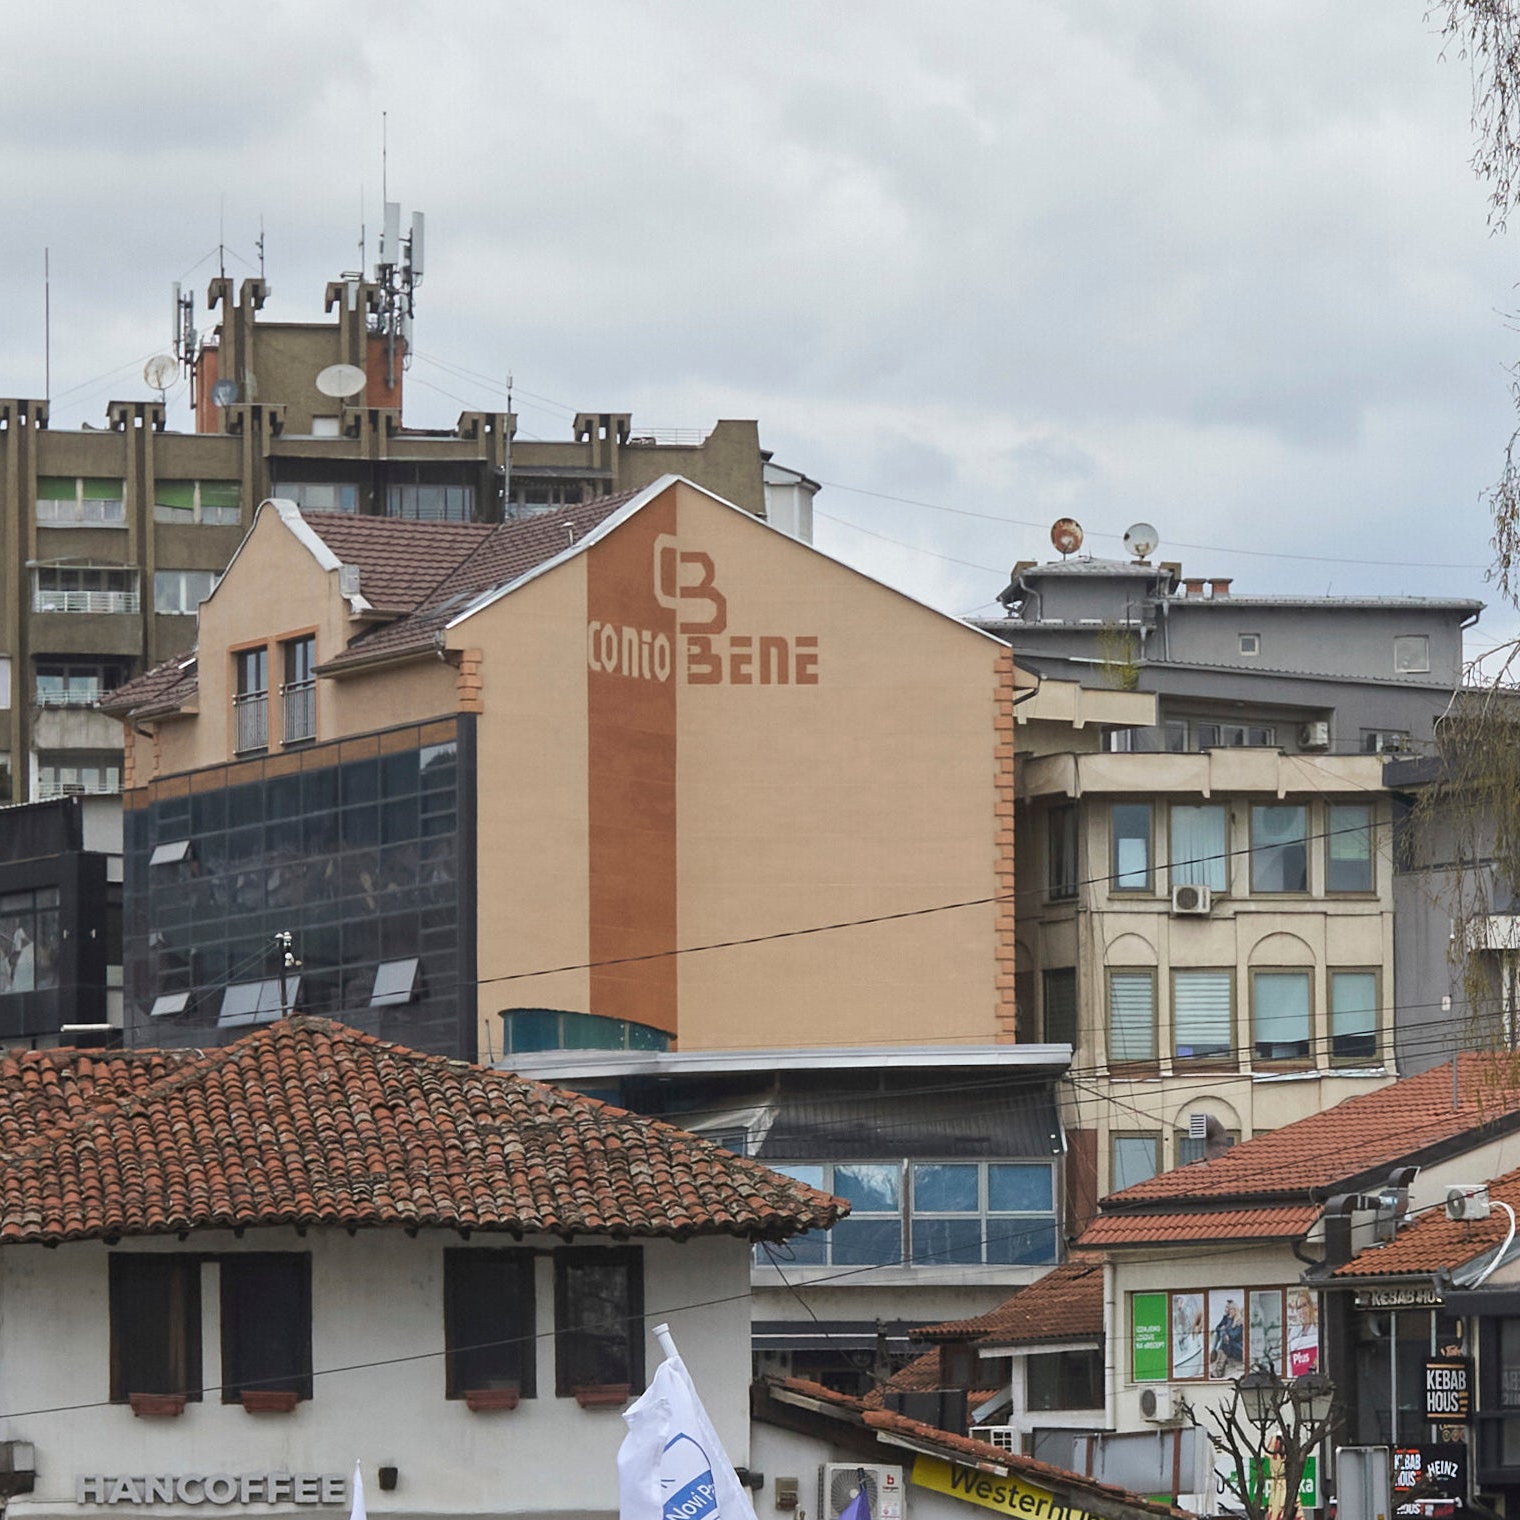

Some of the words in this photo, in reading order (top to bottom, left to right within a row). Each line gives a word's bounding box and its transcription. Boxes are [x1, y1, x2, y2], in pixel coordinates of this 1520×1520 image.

[1426, 1370, 1466, 1390] KEBAB
[1426, 1460, 1459, 1478] HEINZ
[76, 1472, 347, 1504] HANCOFFEE
